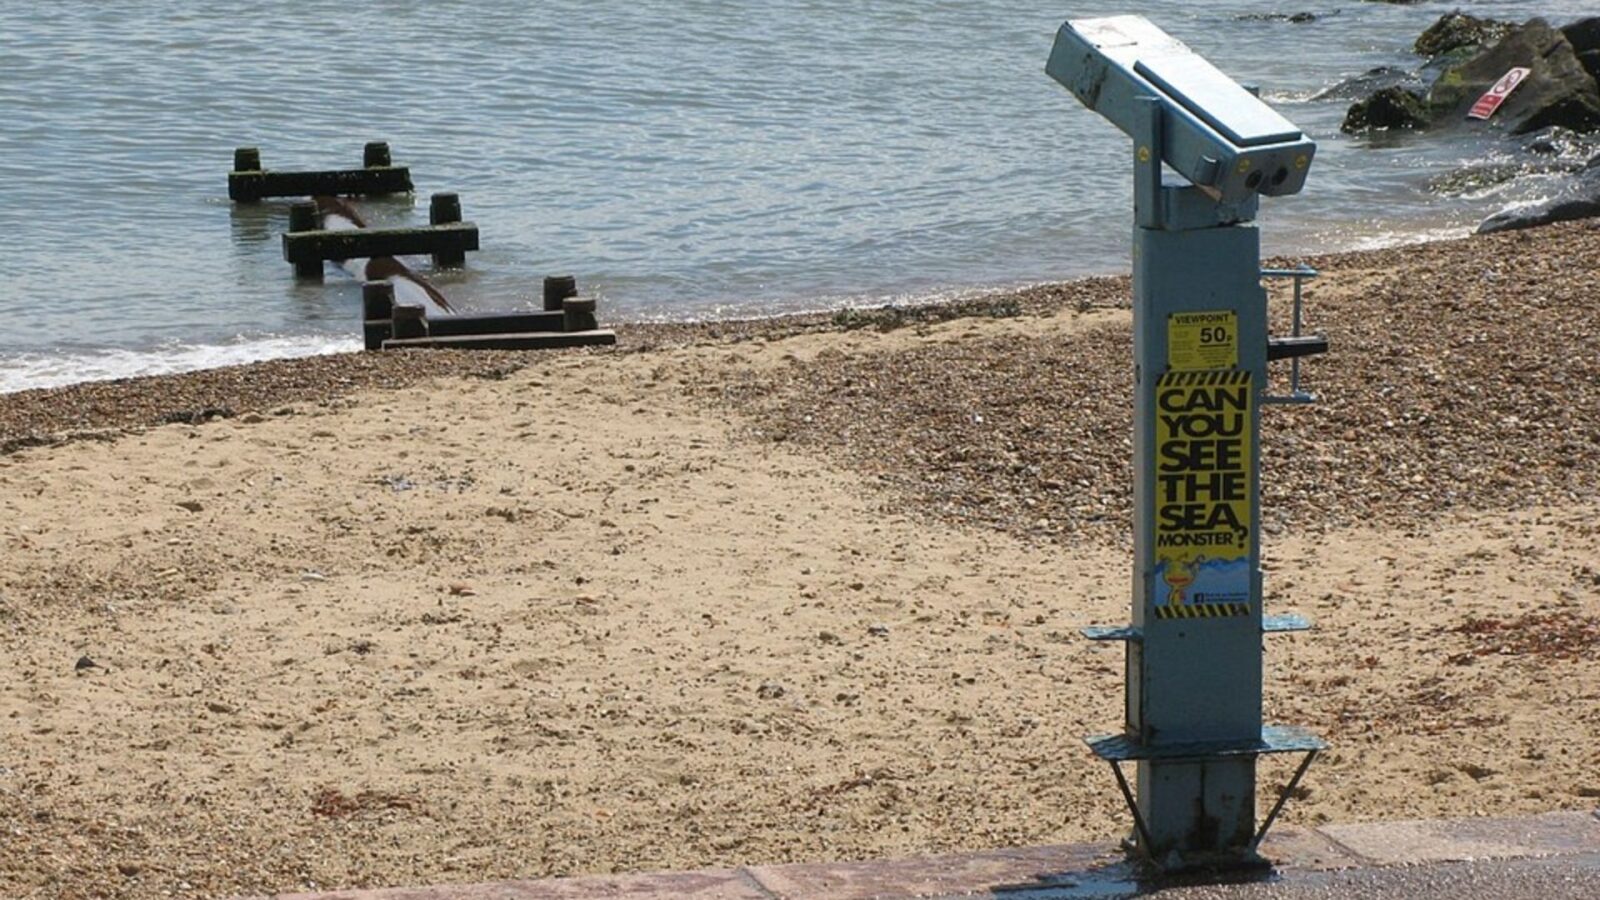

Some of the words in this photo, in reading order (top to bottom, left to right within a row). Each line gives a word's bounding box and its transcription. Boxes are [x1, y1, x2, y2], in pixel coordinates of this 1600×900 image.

[1175, 314, 1229, 325] VIEWPOINT
[1159, 387, 1247, 412] CAN
[1159, 413, 1244, 438] YOU
[1159, 439, 1242, 472] SEE
[1158, 472, 1246, 502] THE
[1159, 503, 1241, 532] SEA
